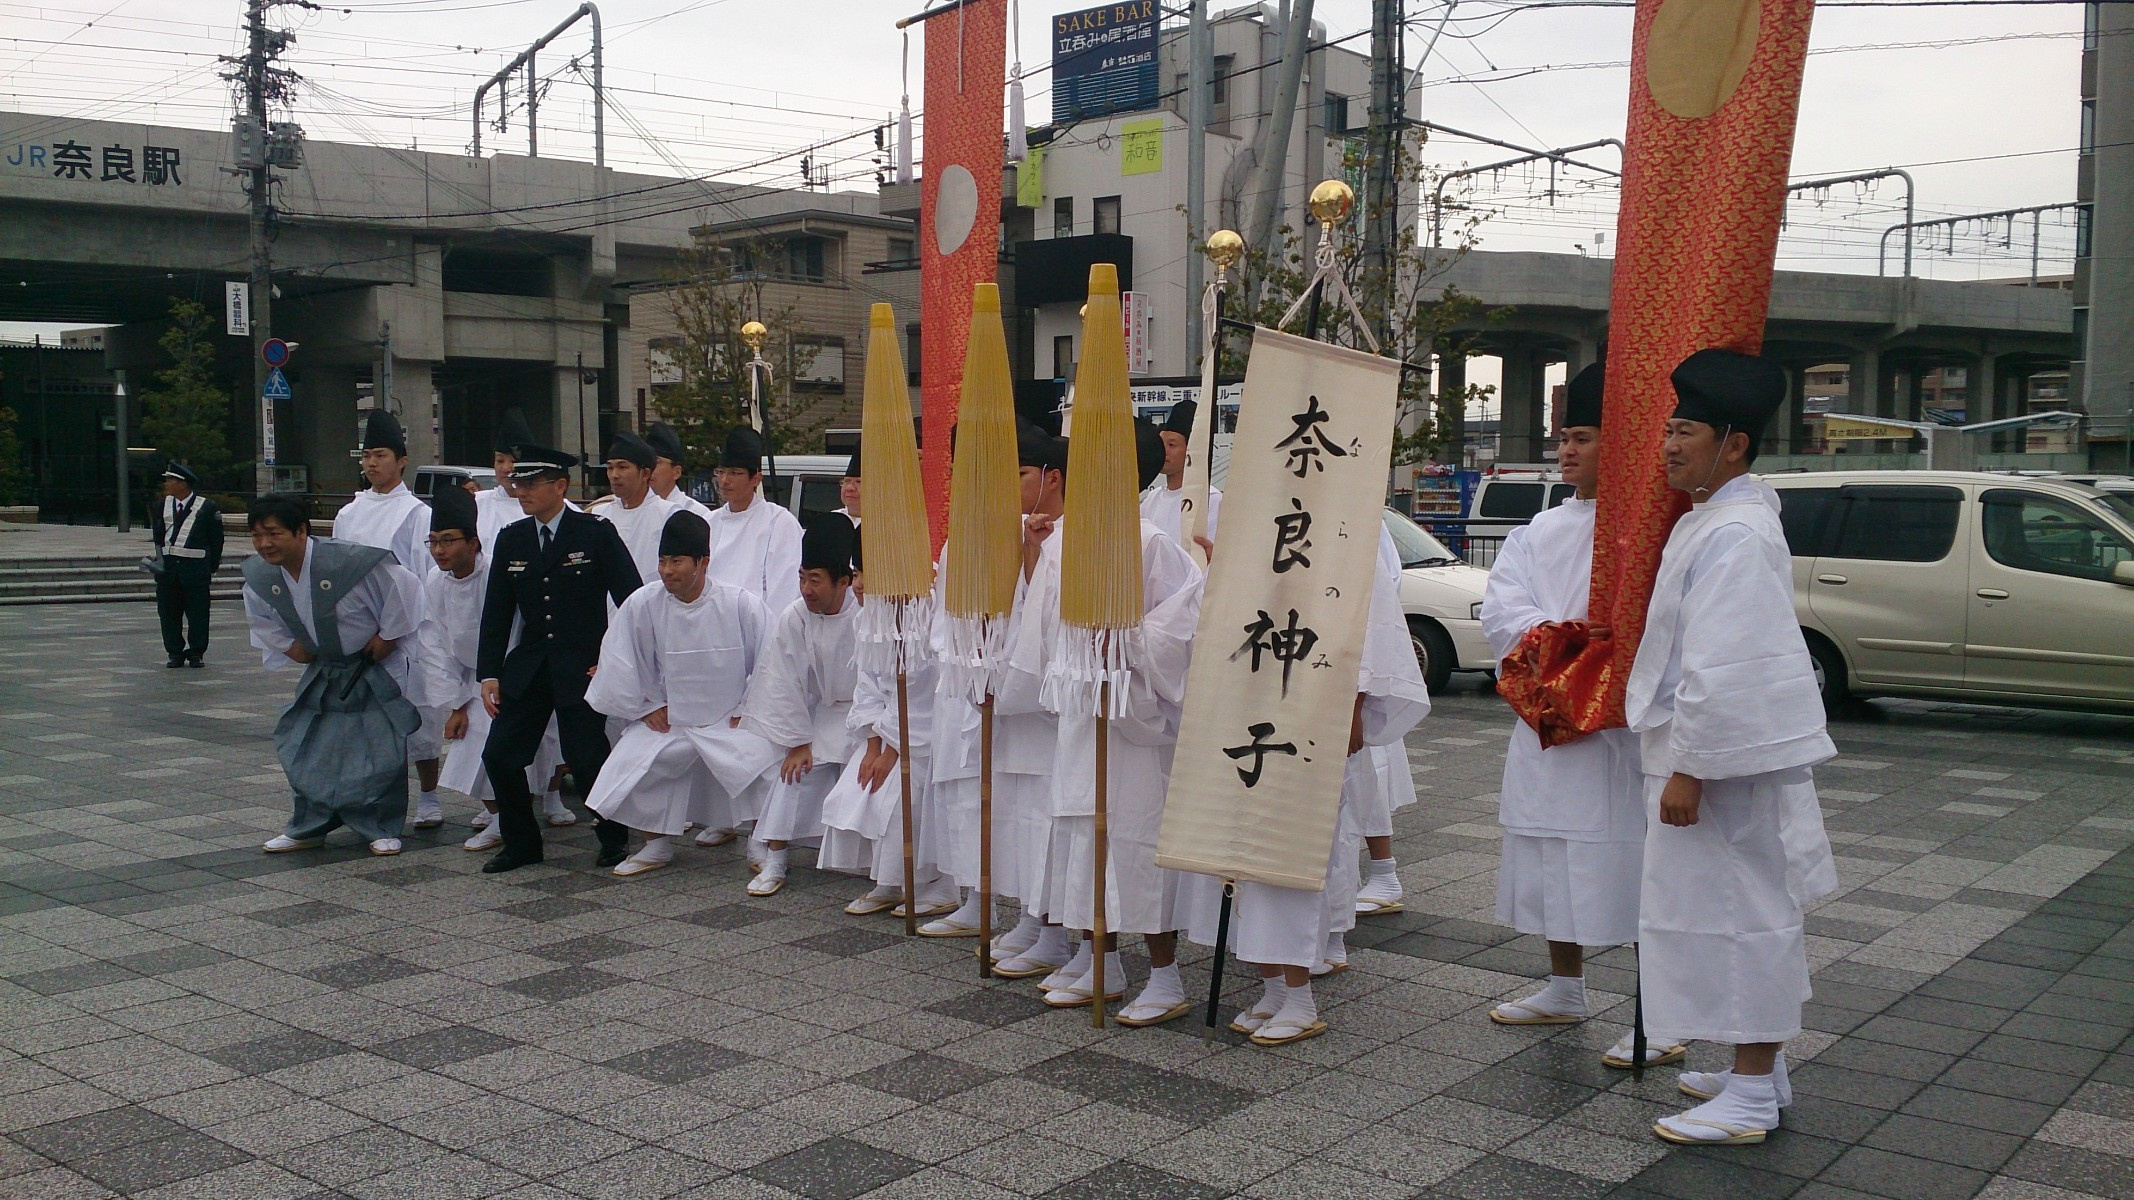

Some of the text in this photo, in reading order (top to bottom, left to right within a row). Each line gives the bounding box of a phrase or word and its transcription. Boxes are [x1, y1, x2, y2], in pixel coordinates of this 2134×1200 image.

[1058, 1, 1153, 34] SAKE BAR
[1125, 140, 1158, 163] 和音
[1222, 395, 1347, 788] 奈良神子
